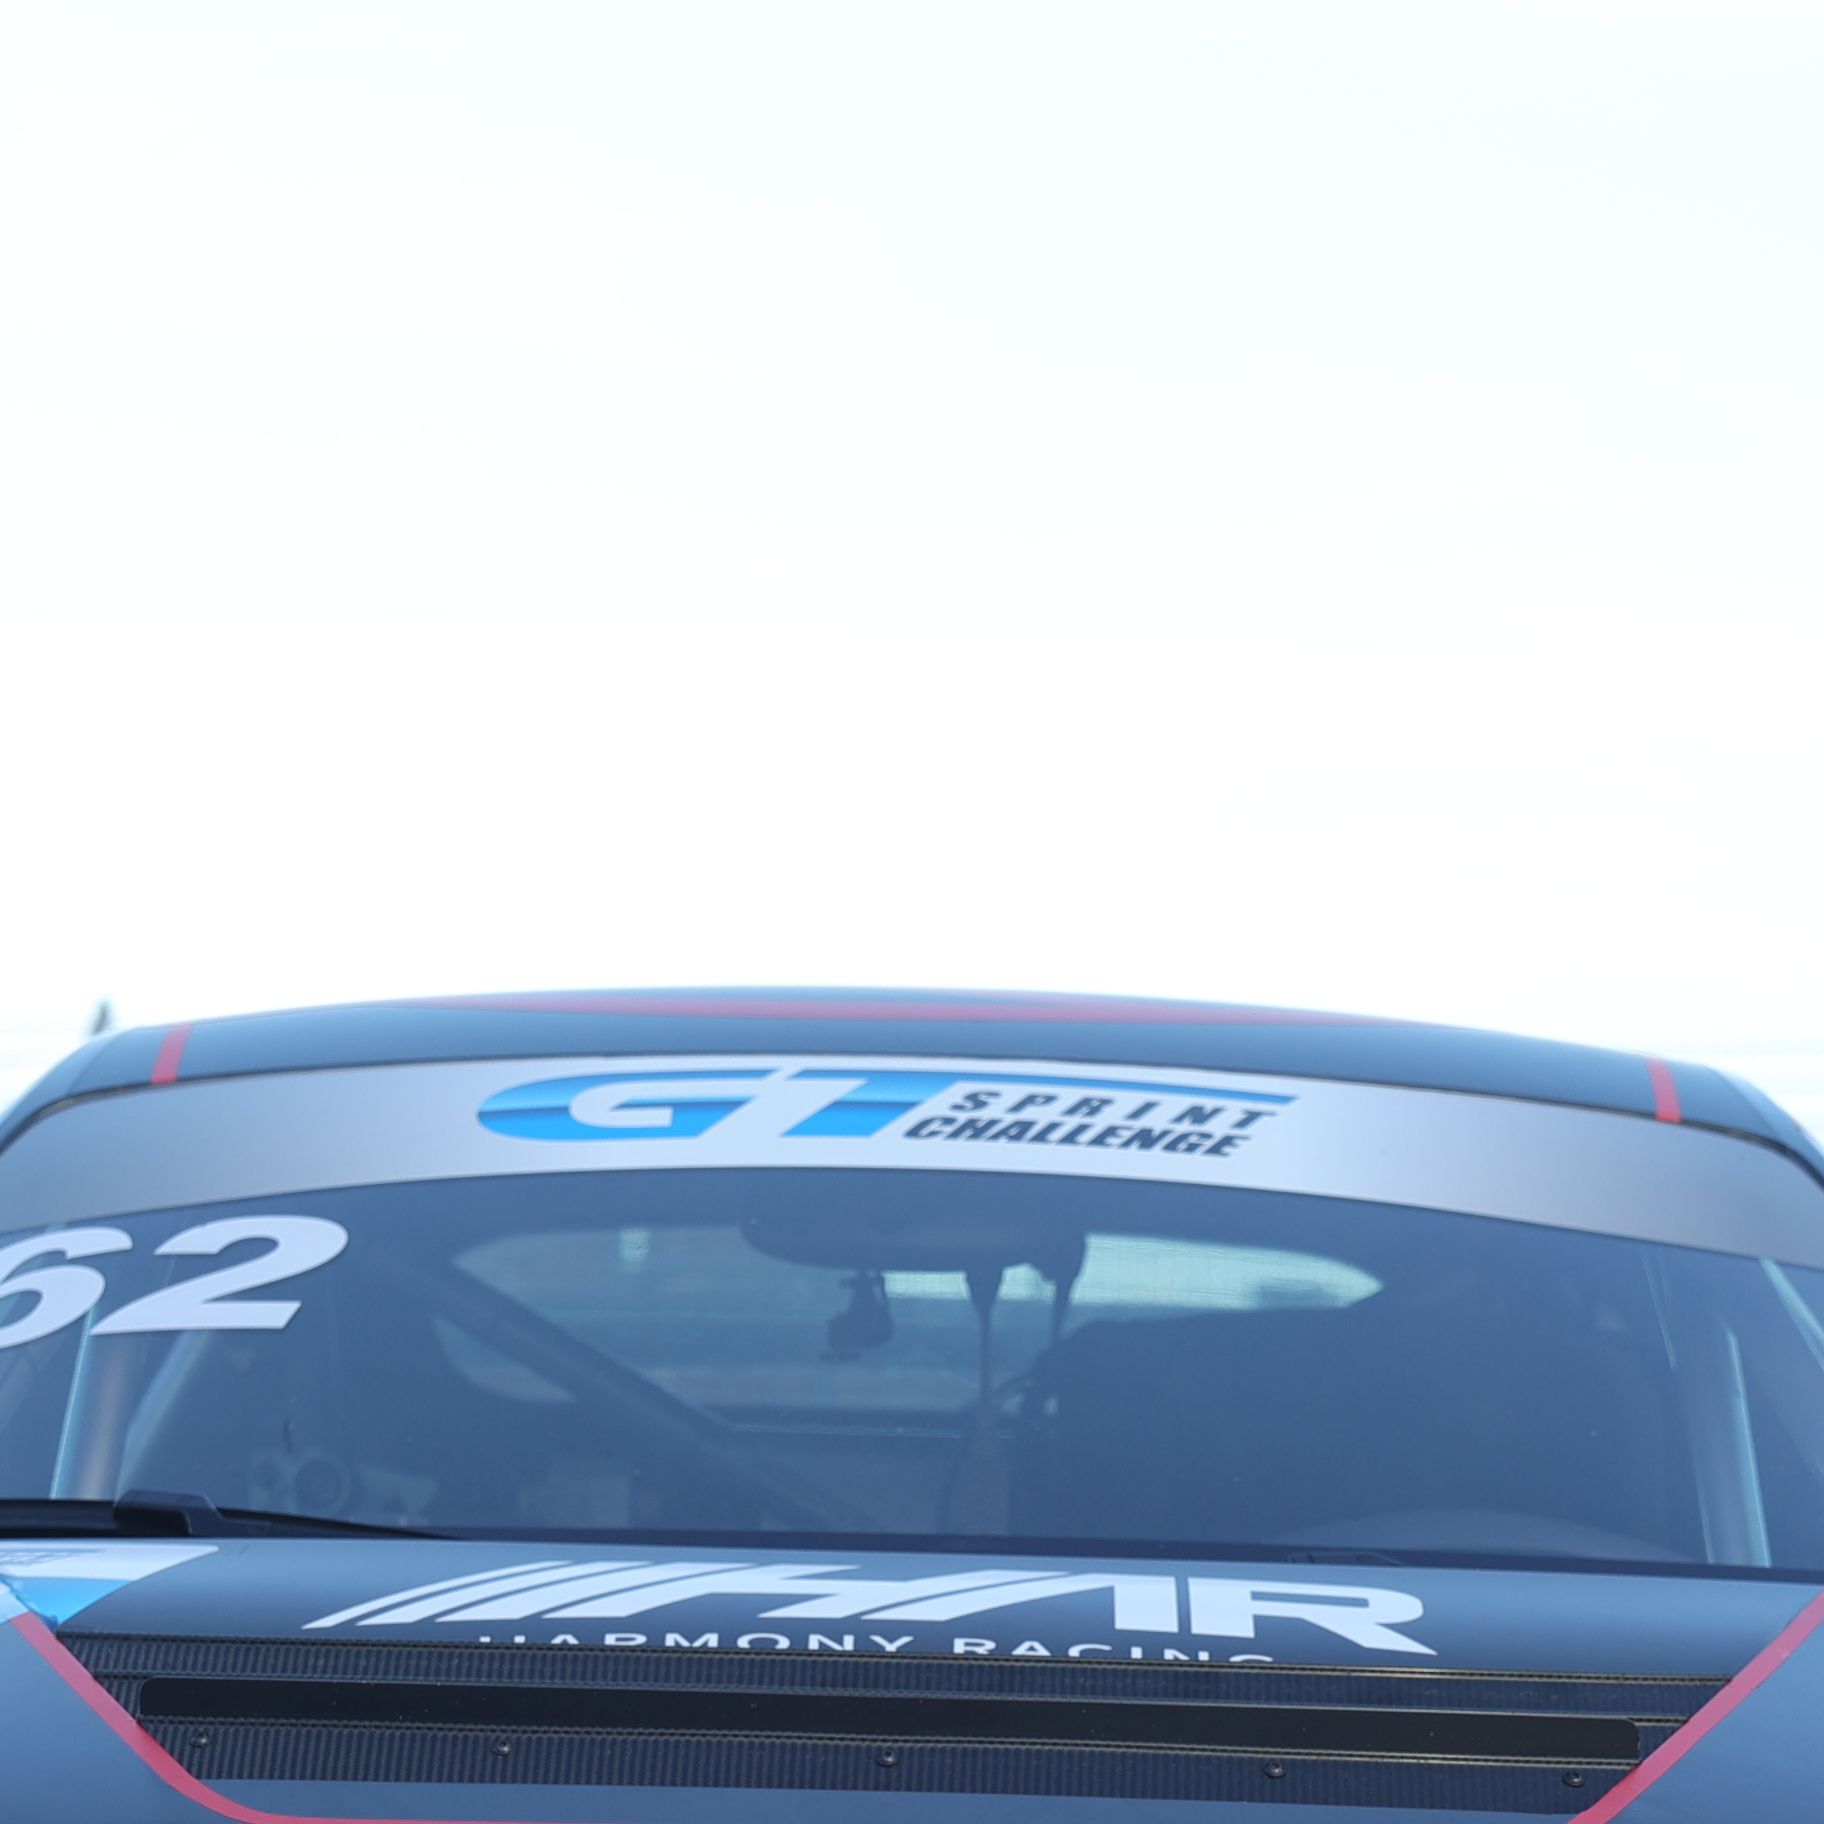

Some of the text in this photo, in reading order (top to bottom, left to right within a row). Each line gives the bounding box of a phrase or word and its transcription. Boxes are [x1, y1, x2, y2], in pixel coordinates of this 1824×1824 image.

[477, 1069, 938, 1142] GT
[949, 1088, 1276, 1131] SPRINT
[903, 1115, 1251, 1158] CHALLENGE
